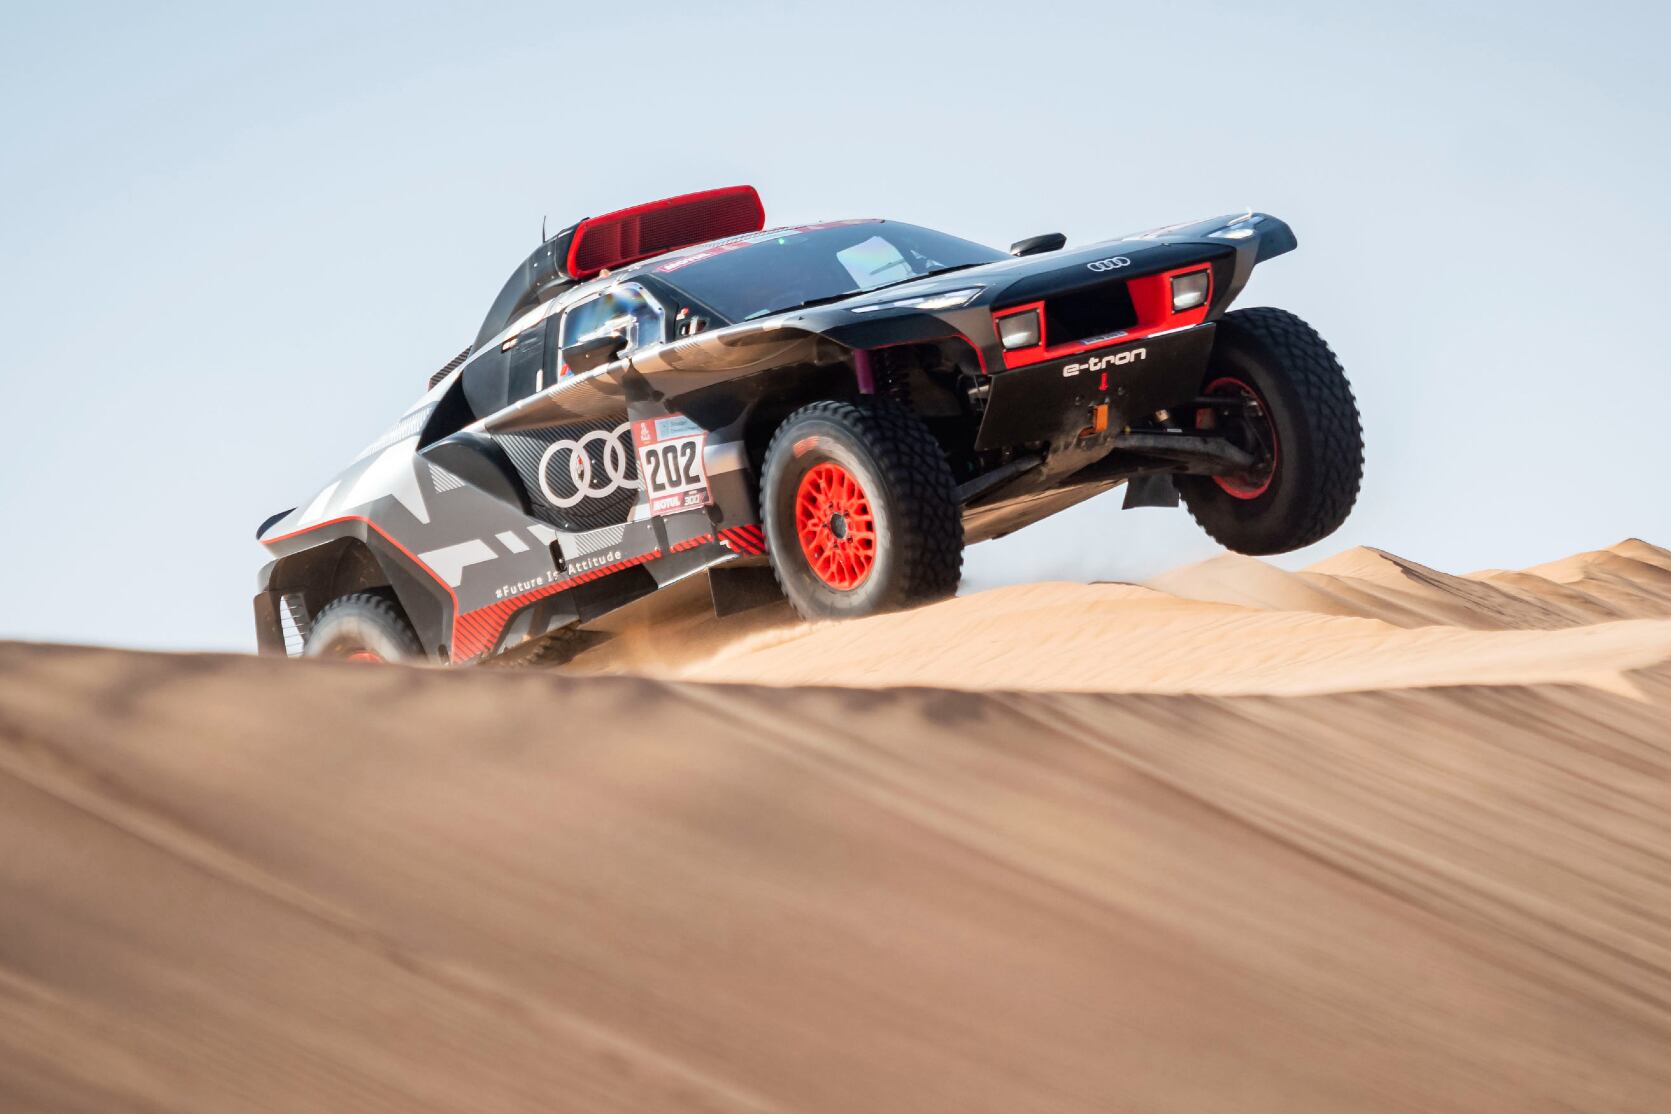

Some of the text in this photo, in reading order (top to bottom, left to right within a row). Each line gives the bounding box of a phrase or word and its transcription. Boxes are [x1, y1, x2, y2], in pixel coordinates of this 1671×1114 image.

[1062, 347, 1147, 378] e-tron
[645, 440, 702, 493] 202
[495, 576, 543, 599] #Future
[568, 550, 622, 576] Attitude
